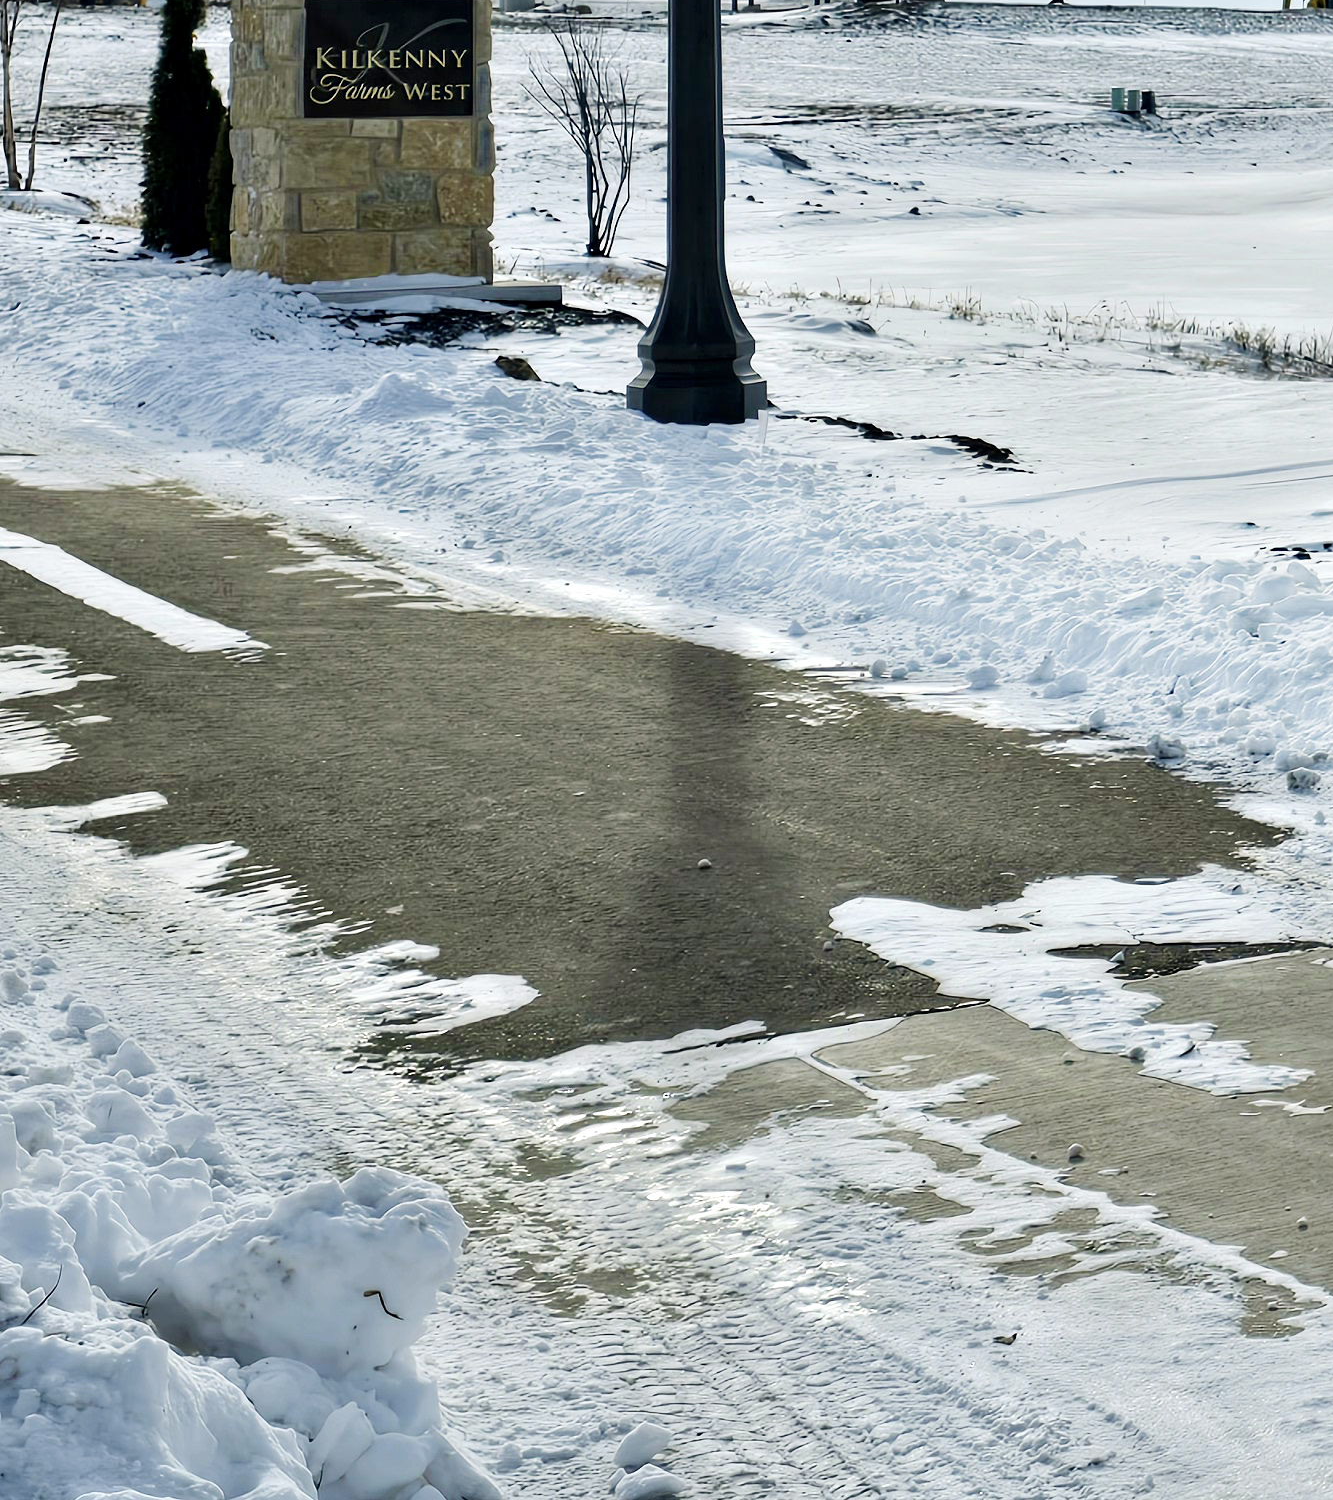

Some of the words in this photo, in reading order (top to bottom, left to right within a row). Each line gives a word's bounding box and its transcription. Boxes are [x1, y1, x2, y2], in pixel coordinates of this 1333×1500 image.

[316, 47, 467, 69] KILKENNY
[309, 73, 396, 105] Farms
[402, 82, 471, 101] WEST
